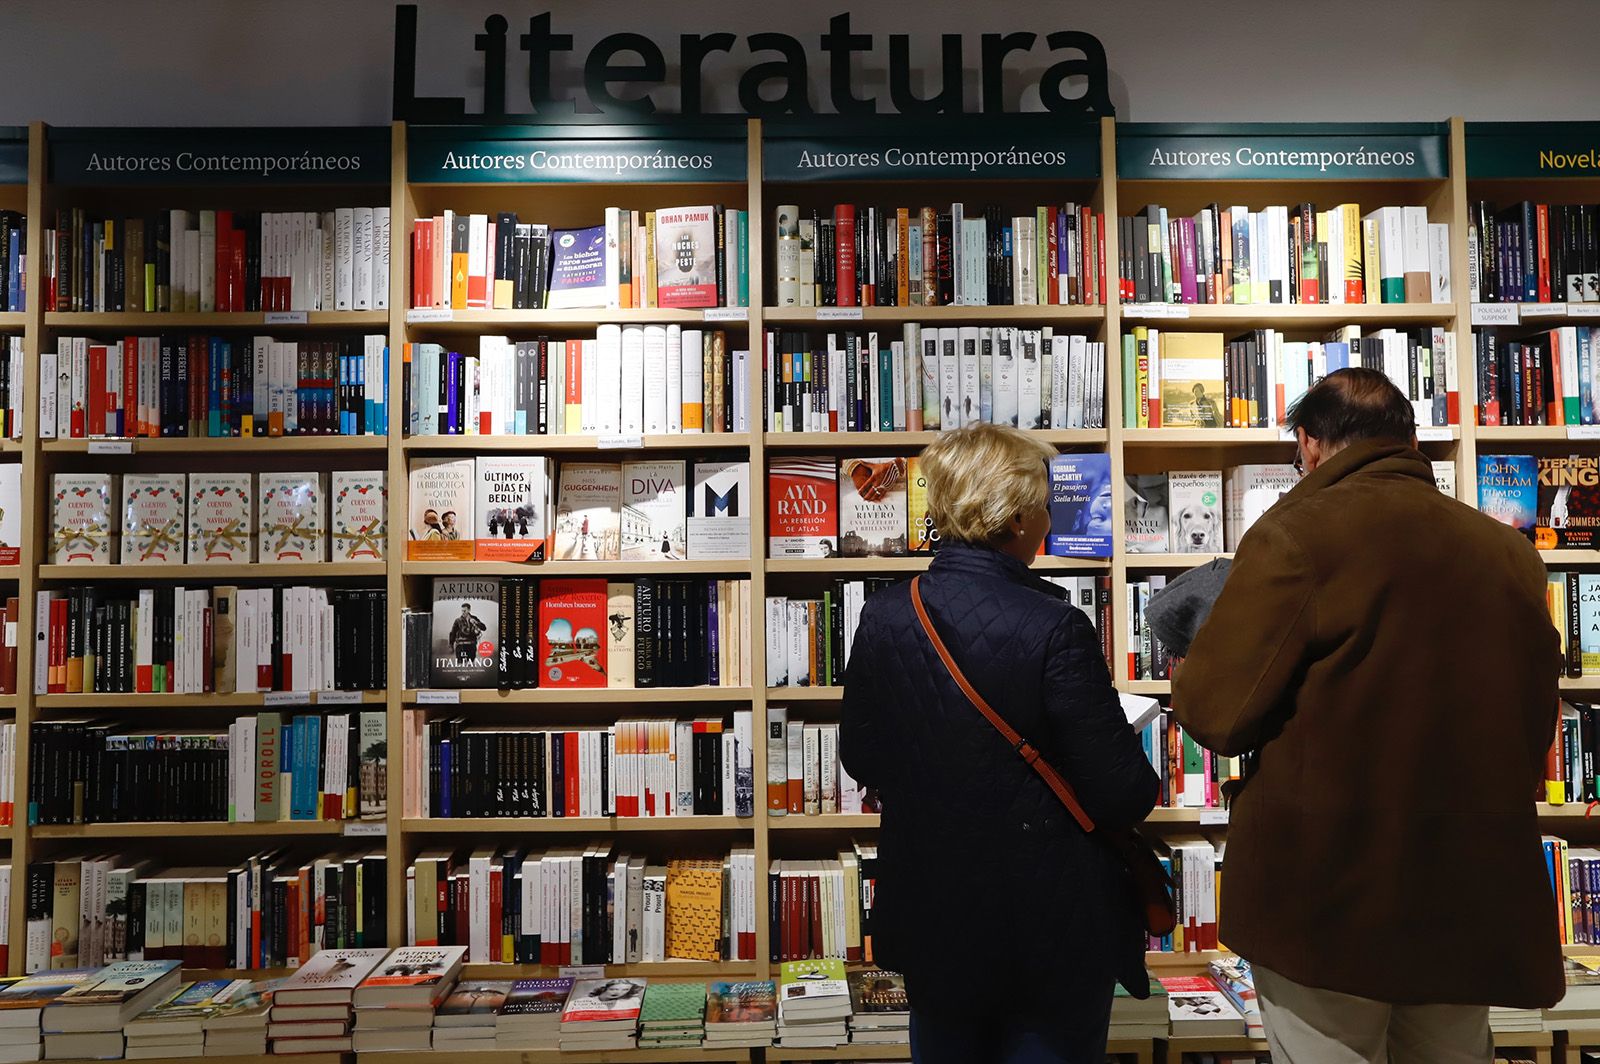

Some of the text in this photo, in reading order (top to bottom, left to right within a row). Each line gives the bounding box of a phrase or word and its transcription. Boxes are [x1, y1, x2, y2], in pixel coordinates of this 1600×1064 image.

[394, 5, 1115, 117] Literatura
[86, 151, 361, 176] Autores Contemporáneos
[441, 149, 714, 175] Autores Contemporáneos
[797, 146, 1066, 171] Autores Contemporáneos
[1149, 146, 1416, 171] Autores Contemporáneos
[661, 213, 709, 225] ORHAN PAMUK
[672, 241, 699, 250] NOCHES
[574, 251, 599, 260] bichos
[675, 257, 697, 267] PESTE
[1433, 334, 1444, 344] 36
[162, 347, 171, 381] DIFERENTE
[178, 347, 187, 381] DIFERENTE
[1537, 457, 1599, 469] STEPHEN
[1053, 464, 1077, 474] CORMAC
[1485, 463, 1520, 474] JOHN
[485, 470, 524, 482] ÚLTIMOS
[1053, 472, 1083, 482] McCARTHY
[1178, 472, 1197, 480] través
[1209, 472, 1219, 480] mis
[1537, 467, 1600, 487] KING
[494, 480, 531, 493] DÍAS EN
[563, 484, 619, 492] GUGGENHEIM
[631, 478, 676, 495] DIVA
[1053, 483, 1088, 494] El pasajero
[1172, 481, 1205, 490] pequeños
[488, 491, 523, 503] BERLÍN
[784, 484, 818, 500] AYN
[1482, 488, 1522, 498] TIEMPO
[350, 498, 377, 506] CUENTOS
[704, 481, 739, 517] M
[1053, 494, 1091, 503] Stella Maris
[68, 501, 94, 509] CUENTOS
[141, 501, 168, 509] CUENTOS
[206, 501, 233, 509] CUENTOS
[777, 499, 828, 515] RAND
[854, 504, 896, 512] VIVIANA
[76, 509, 84, 517] DE
[150, 509, 158, 517] DE
[350, 514, 377, 522] NAVIDAD
[68, 517, 94, 525] NAVIDAD
[141, 517, 167, 525] NAVIDAD
[206, 516, 233, 524] NAVIDAD
[779, 516, 826, 526] LA REBELIÓN
[1125, 520, 1160, 528] MANUEL
[1536, 516, 1600, 527] ILLY SUMMERS
[786, 525, 821, 535] DE ATLAS
[439, 583, 495, 594] ARTURO
[545, 601, 573, 609] Hombres
[642, 585, 652, 633] ARTURO
[637, 637, 645, 670] FUEGO
[435, 657, 493, 669] ITALIANO
[260, 727, 275, 803] MAQROLL
